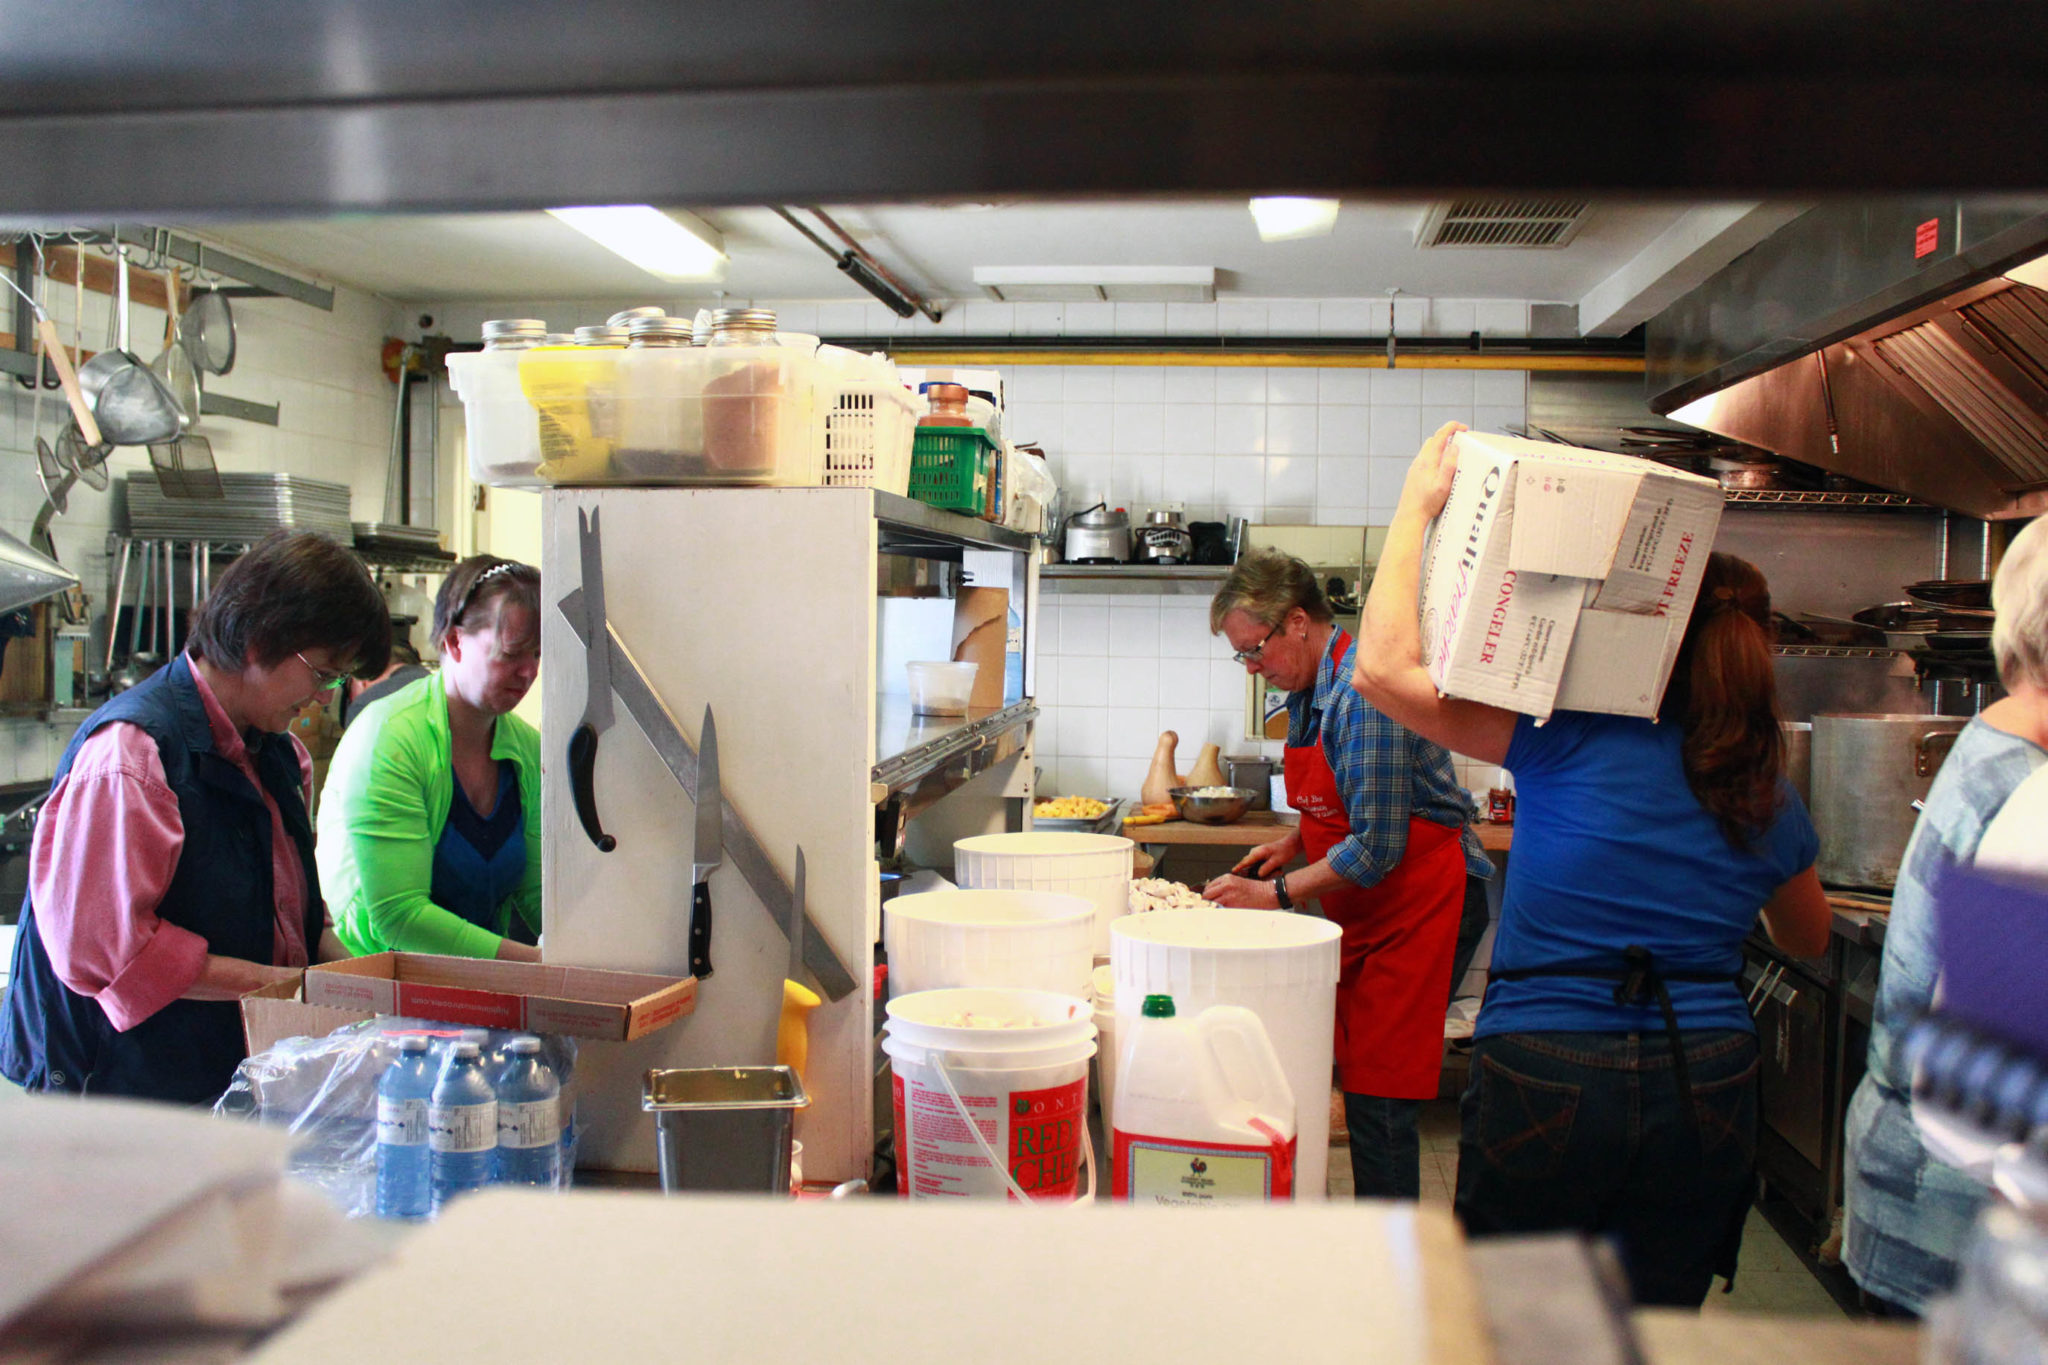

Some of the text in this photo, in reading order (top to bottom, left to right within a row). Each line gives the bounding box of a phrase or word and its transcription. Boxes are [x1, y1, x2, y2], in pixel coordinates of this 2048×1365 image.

[1662, 531, 1695, 597] FREEZE
[1479, 570, 1518, 664] CONGELER
[1016, 1119, 1073, 1157] RED
